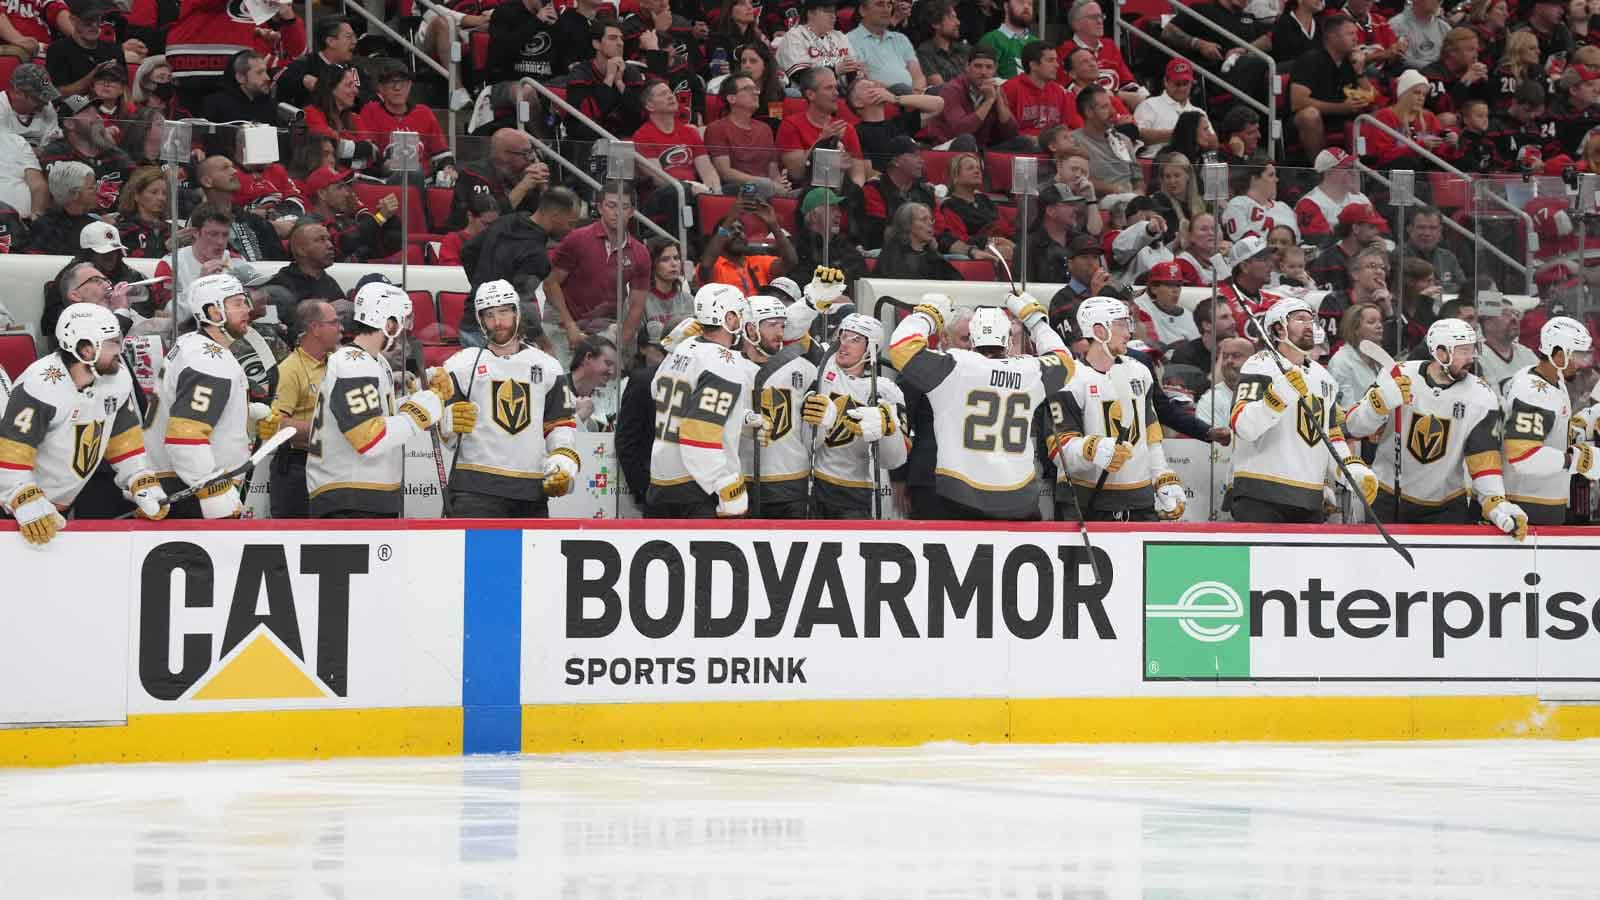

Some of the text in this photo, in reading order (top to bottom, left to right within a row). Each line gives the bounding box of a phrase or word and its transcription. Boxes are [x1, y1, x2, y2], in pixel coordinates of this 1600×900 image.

[982, 325, 993, 335] 26
[1057, 319, 1073, 339] 74
[989, 369, 1022, 390] DOWD
[190, 384, 213, 412] 5
[345, 384, 381, 414] 52
[698, 387, 734, 417] 22
[14, 407, 36, 434] 4
[963, 389, 1031, 454] 26
[560, 539, 1117, 640] BODYARMOR
[139, 541, 370, 701] CAT
[1146, 572, 1600, 658] enterpris
[564, 656, 808, 685] SPORTS DRINK
